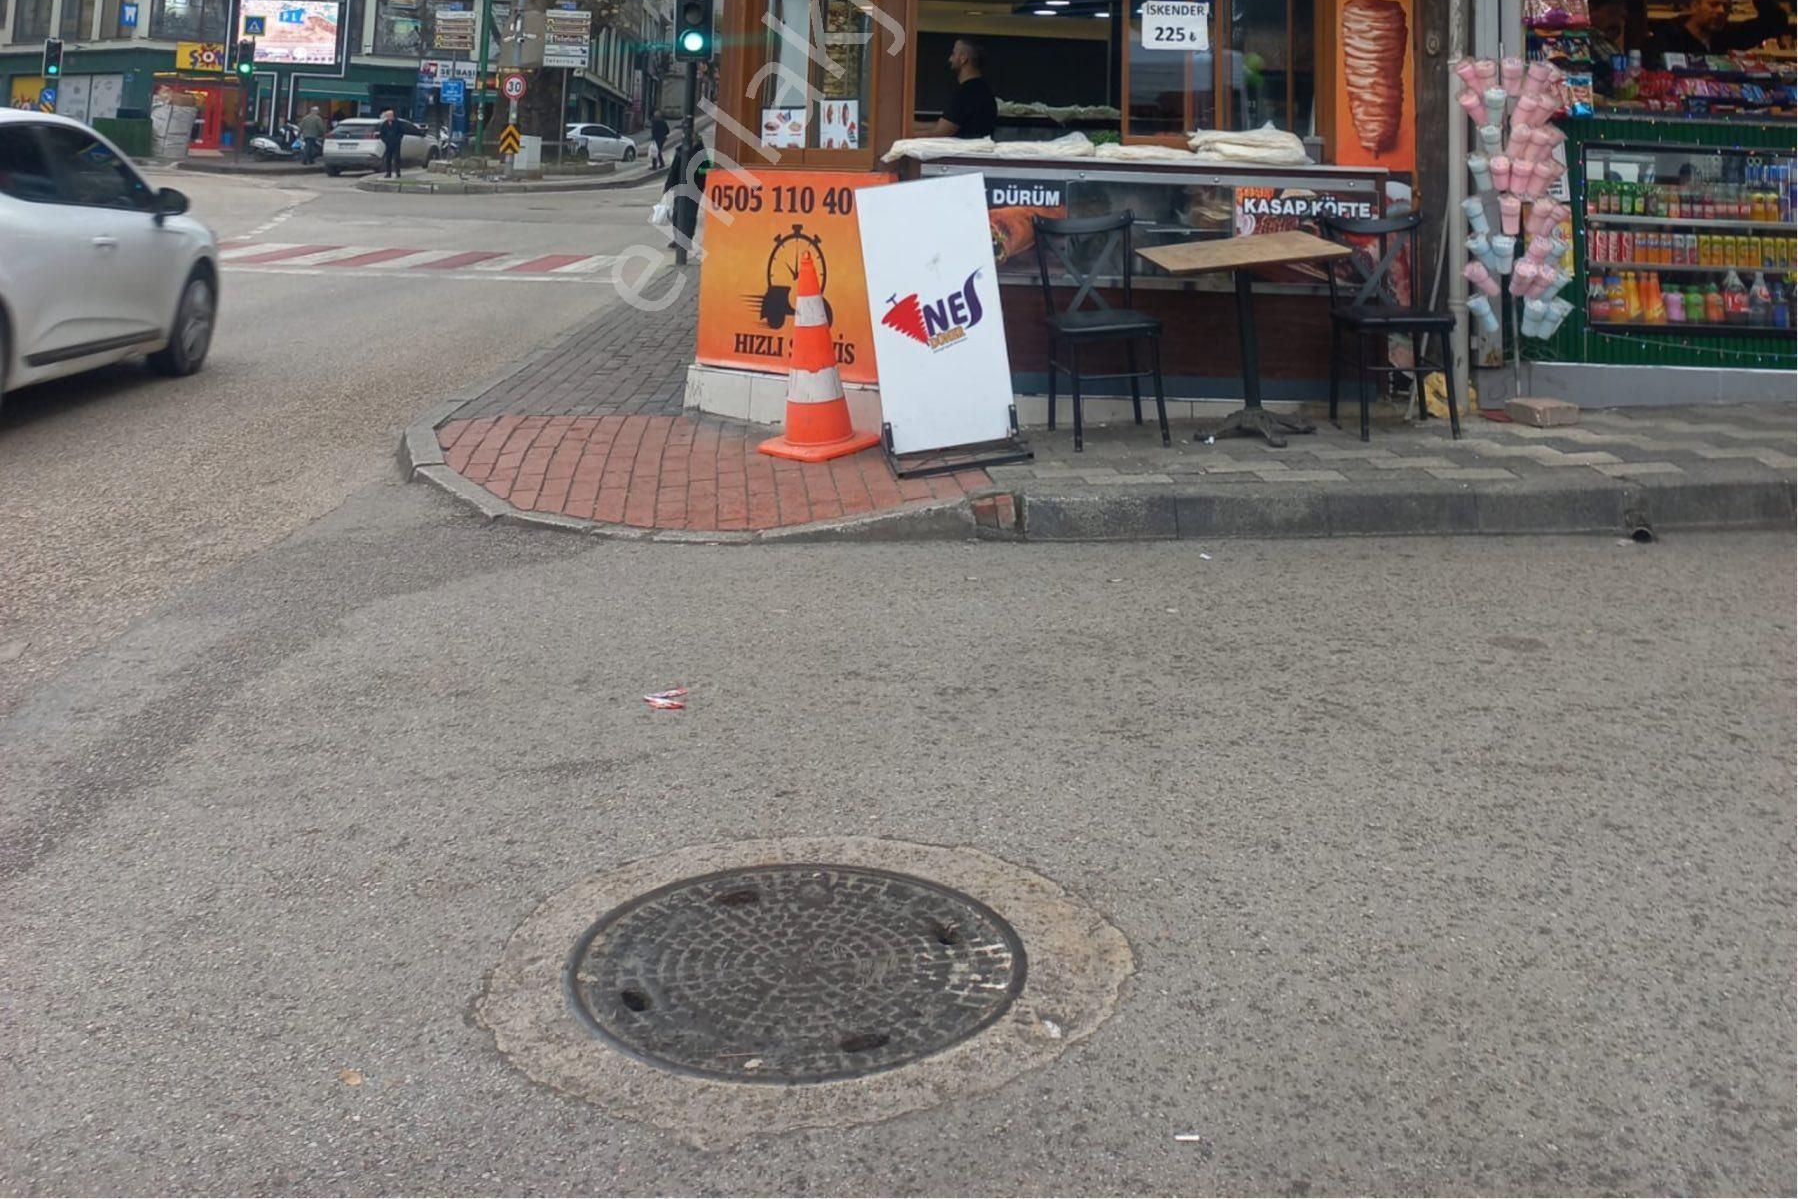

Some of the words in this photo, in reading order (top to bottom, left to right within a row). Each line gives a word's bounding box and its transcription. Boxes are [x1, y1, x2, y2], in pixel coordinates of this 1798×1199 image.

[1146, 2, 1205, 16] İSKENDER
[1155, 26, 1185, 42] 225
[508, 82, 522, 93] 30
[711, 185, 763, 213] 0505
[772, 186, 815, 214] 110
[822, 187, 854, 215] 40
[992, 184, 1060, 207] DÜRÜM
[1244, 198, 1307, 215] KASAP
[1312, 196, 1371, 218] KÖFTE
[734, 334, 783, 358] HIZLI
